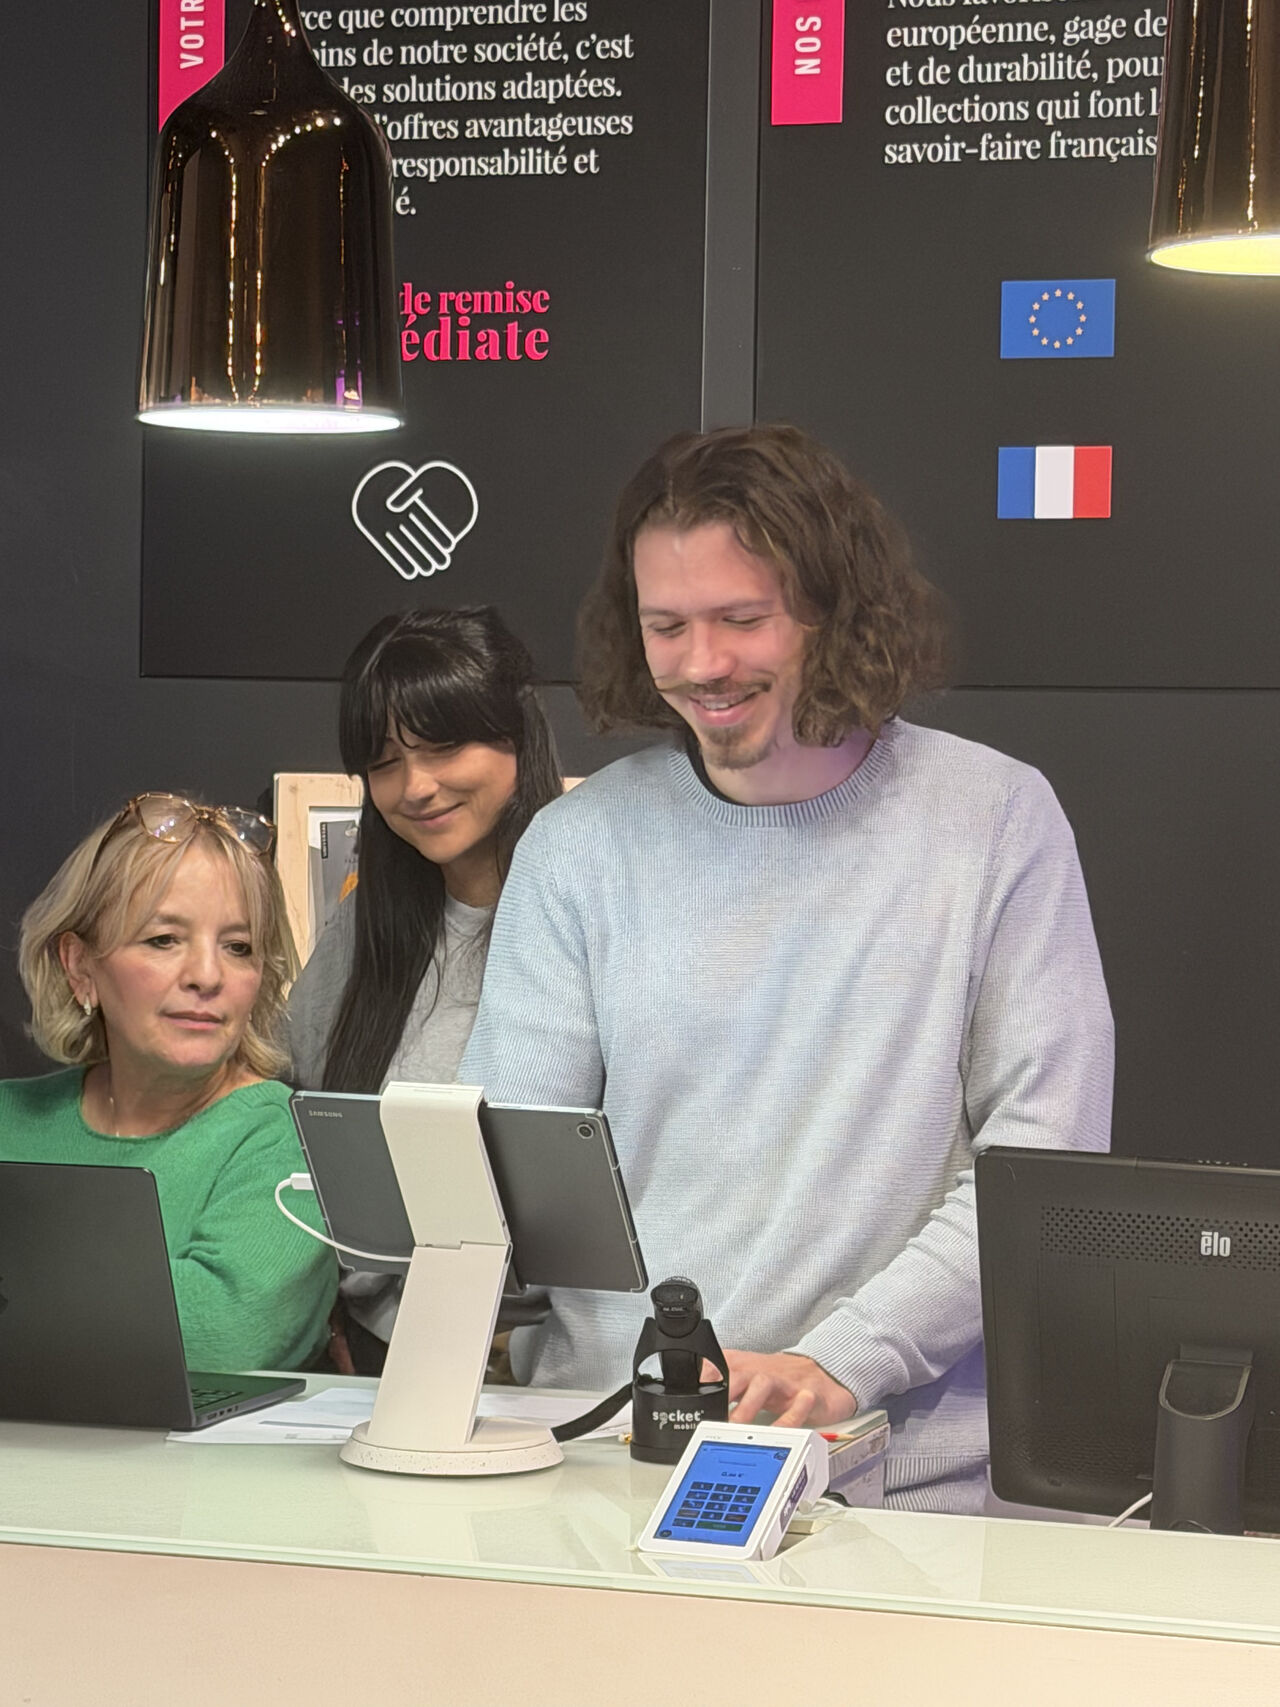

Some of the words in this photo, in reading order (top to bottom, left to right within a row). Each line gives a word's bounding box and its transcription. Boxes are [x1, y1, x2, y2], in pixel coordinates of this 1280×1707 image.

[338, 8, 384, 35] que
[391, 0, 547, 31] comprendre
[553, 0, 587, 22] les
[886, 14, 1056, 51] européenne,
[1063, 14, 1127, 46] gage
[1134, 8, 1167, 38] de
[363, 38, 393, 66] de
[400, 39, 467, 66] notre
[474, 31, 569, 64] société,
[576, 33, 634, 60] c’est
[794, 16, 822, 75] NOS
[886, 60, 913, 87] et
[918, 55, 951, 85] de
[958, 49, 1098, 84] durabilité,
[383, 74, 496, 104] solutions
[502, 69, 622, 104] adaptées.
[885, 94, 1030, 126] collections
[1036, 91, 1080, 125] qui
[1088, 90, 1145, 118] font
[465, 113, 634, 142] avantageuses
[392, 145, 567, 182] responsabilité
[574, 148, 599, 174] et
[884, 132, 1041, 164] savoir-faire
[1048, 128, 1158, 163] français
[438, 280, 550, 315] remise
[401, 313, 550, 361] édiate
[652, 1409, 701, 1426] socket
